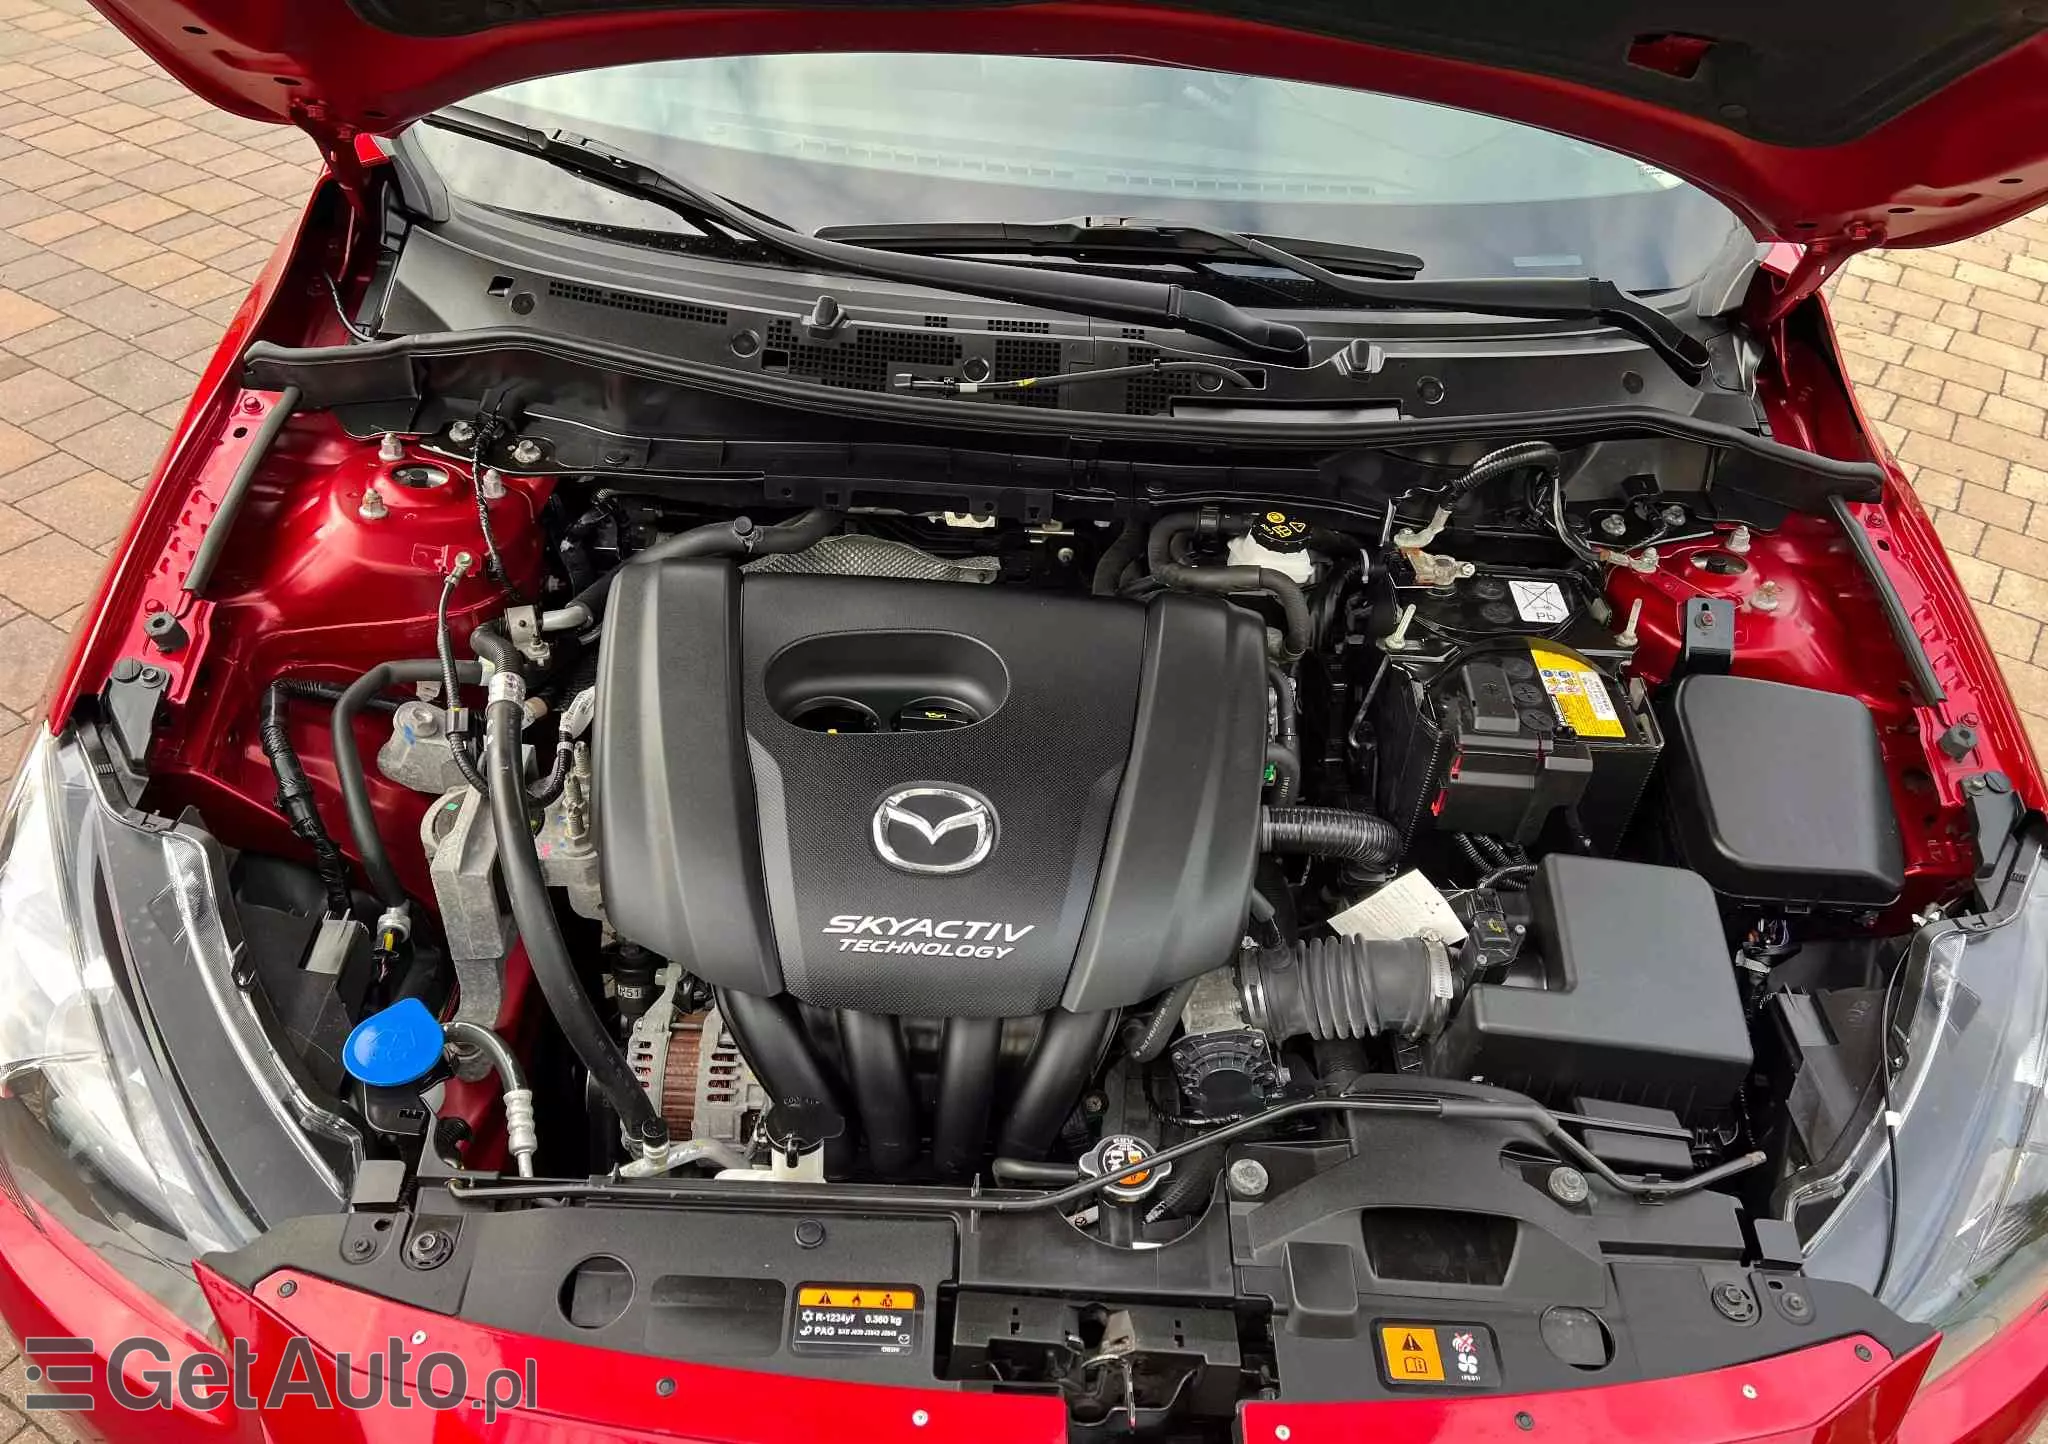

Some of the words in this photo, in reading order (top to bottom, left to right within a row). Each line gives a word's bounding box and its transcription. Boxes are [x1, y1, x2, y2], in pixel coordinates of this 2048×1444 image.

[822, 914, 1035, 942] SKYACTIV
[838, 938, 1016, 960] TECHNOLOGY
[815, 1311, 856, 1325] R-1234yf
[890, 1315, 903, 1326] kg
[814, 1326, 835, 1336] PAG
